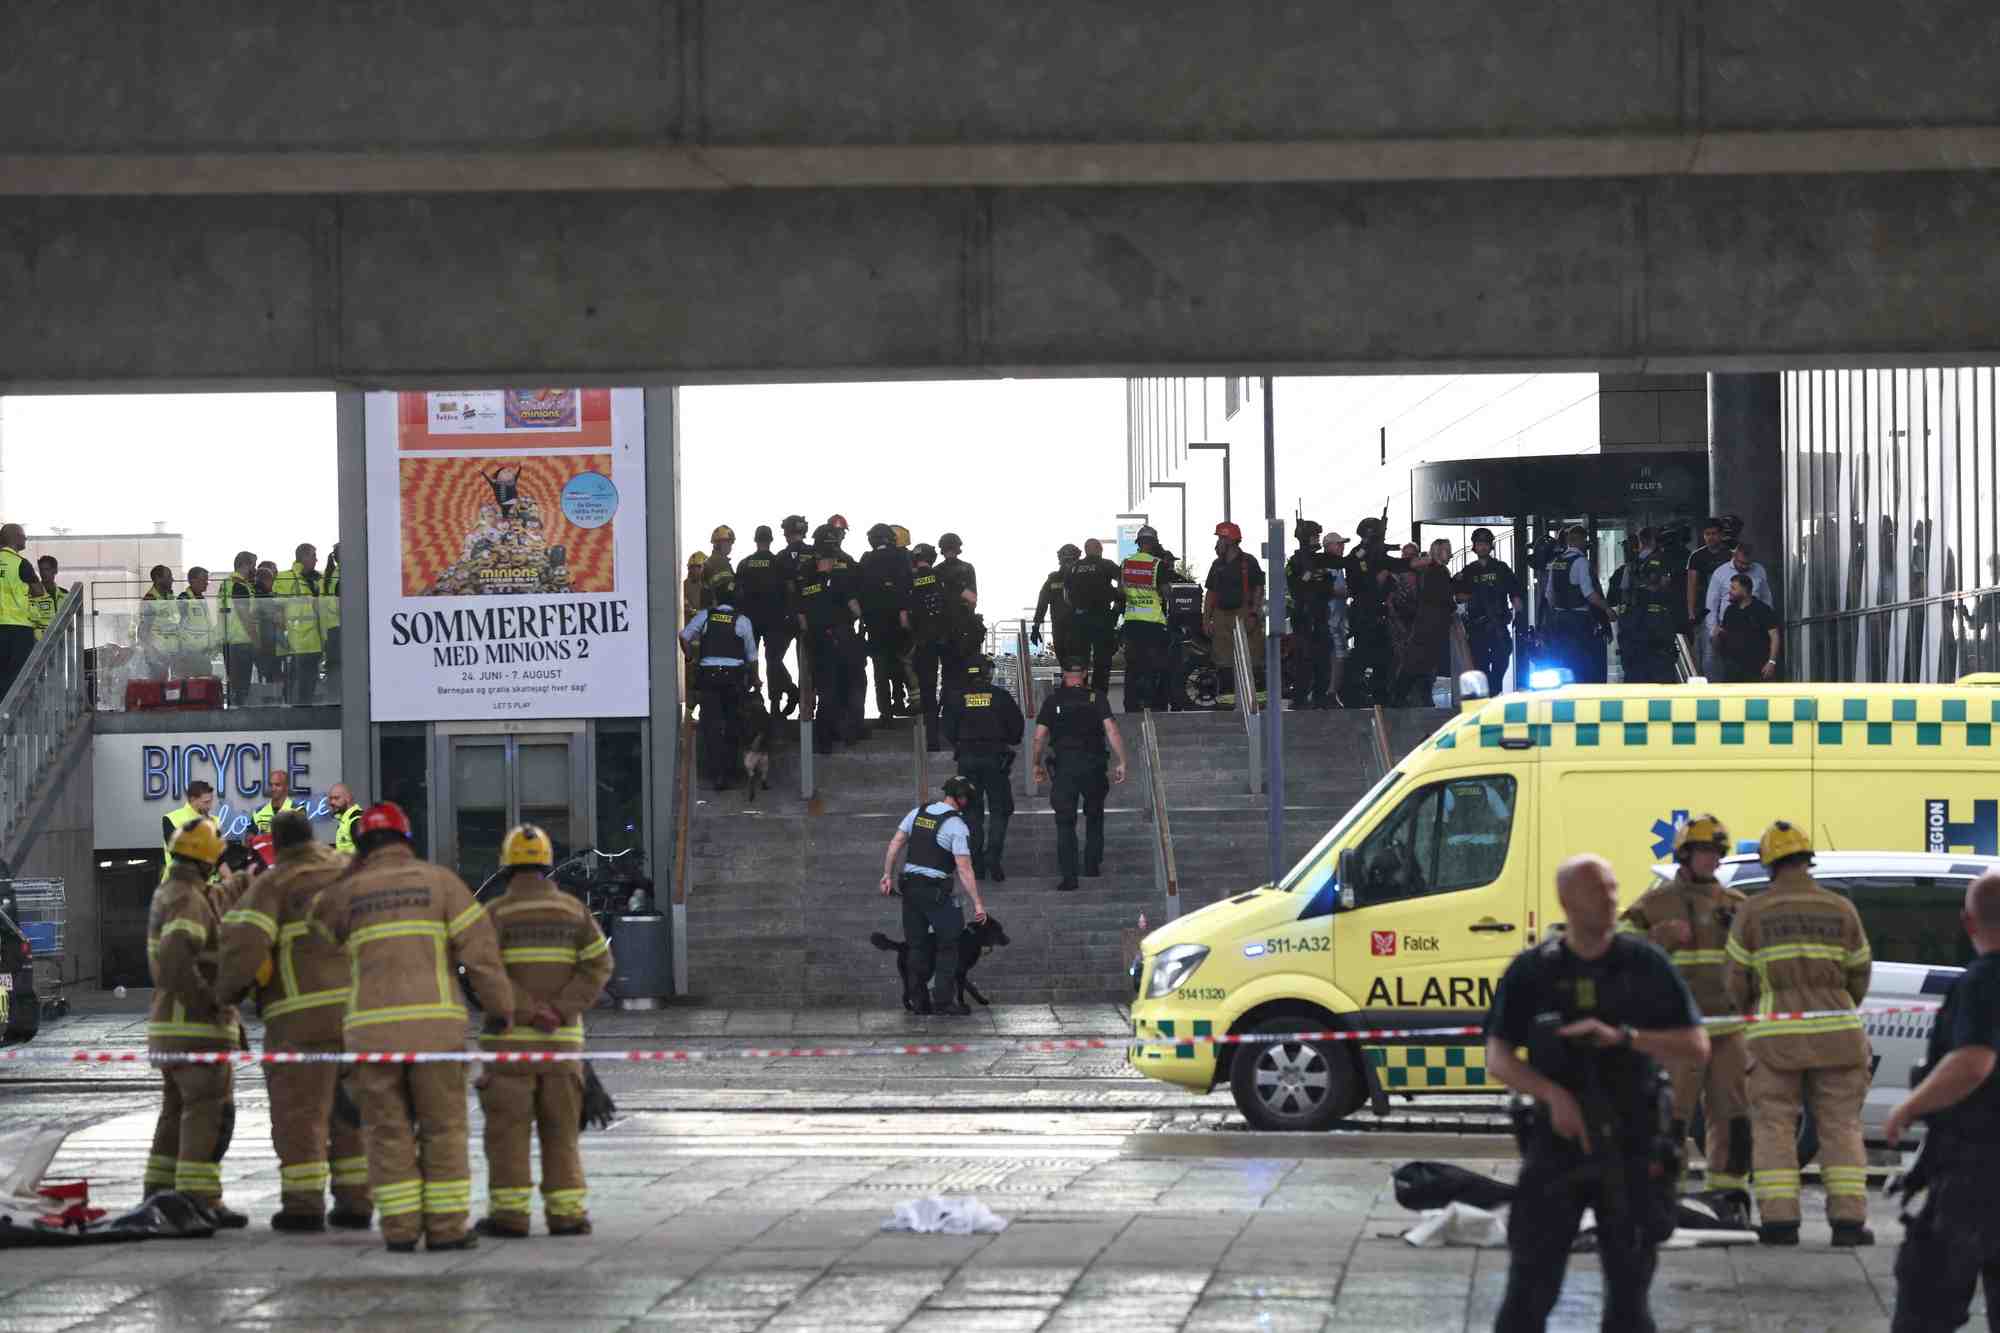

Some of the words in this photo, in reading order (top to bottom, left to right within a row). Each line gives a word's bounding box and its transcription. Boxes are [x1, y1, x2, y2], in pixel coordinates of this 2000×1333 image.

[480, 568, 538, 578] minions
[391, 600, 630, 646] SOMMERFERIE
[433, 645, 479, 667] MED
[485, 639, 572, 664] MINIONS
[577, 638, 590, 659] 2
[479, 671, 502, 681] JUNI
[522, 669, 562, 680] AUGUST
[142, 741, 312, 800] BICYCLE
[1929, 801, 1945, 854] EGION
[1266, 936, 1330, 953] 511-A32
[1403, 936, 1440, 952] Falck
[1366, 976, 1503, 1007] ALARM
